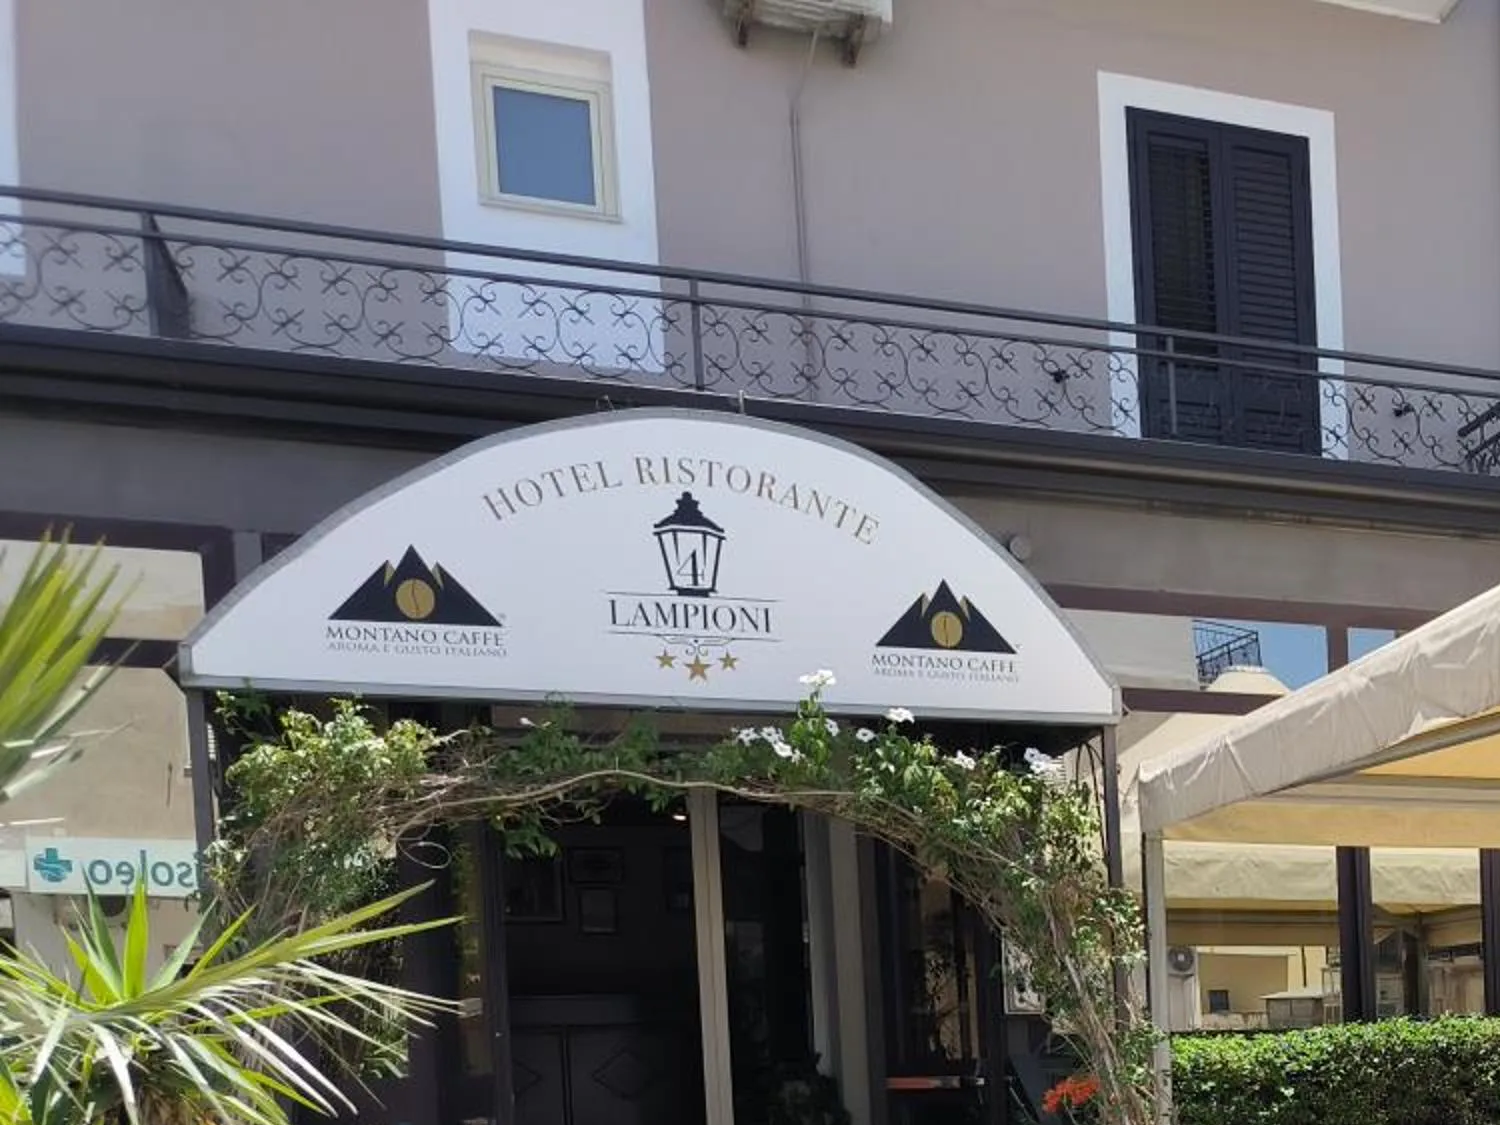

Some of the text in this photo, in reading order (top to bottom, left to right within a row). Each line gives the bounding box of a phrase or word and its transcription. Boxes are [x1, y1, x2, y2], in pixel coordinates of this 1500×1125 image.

[482, 456, 880, 546] HOTEL RISTORANTE
[676, 549, 705, 587] 4
[609, 599, 771, 633] LAMPIONI
[325, 626, 437, 644] MONTANO
[871, 653, 963, 671] MONTANO
